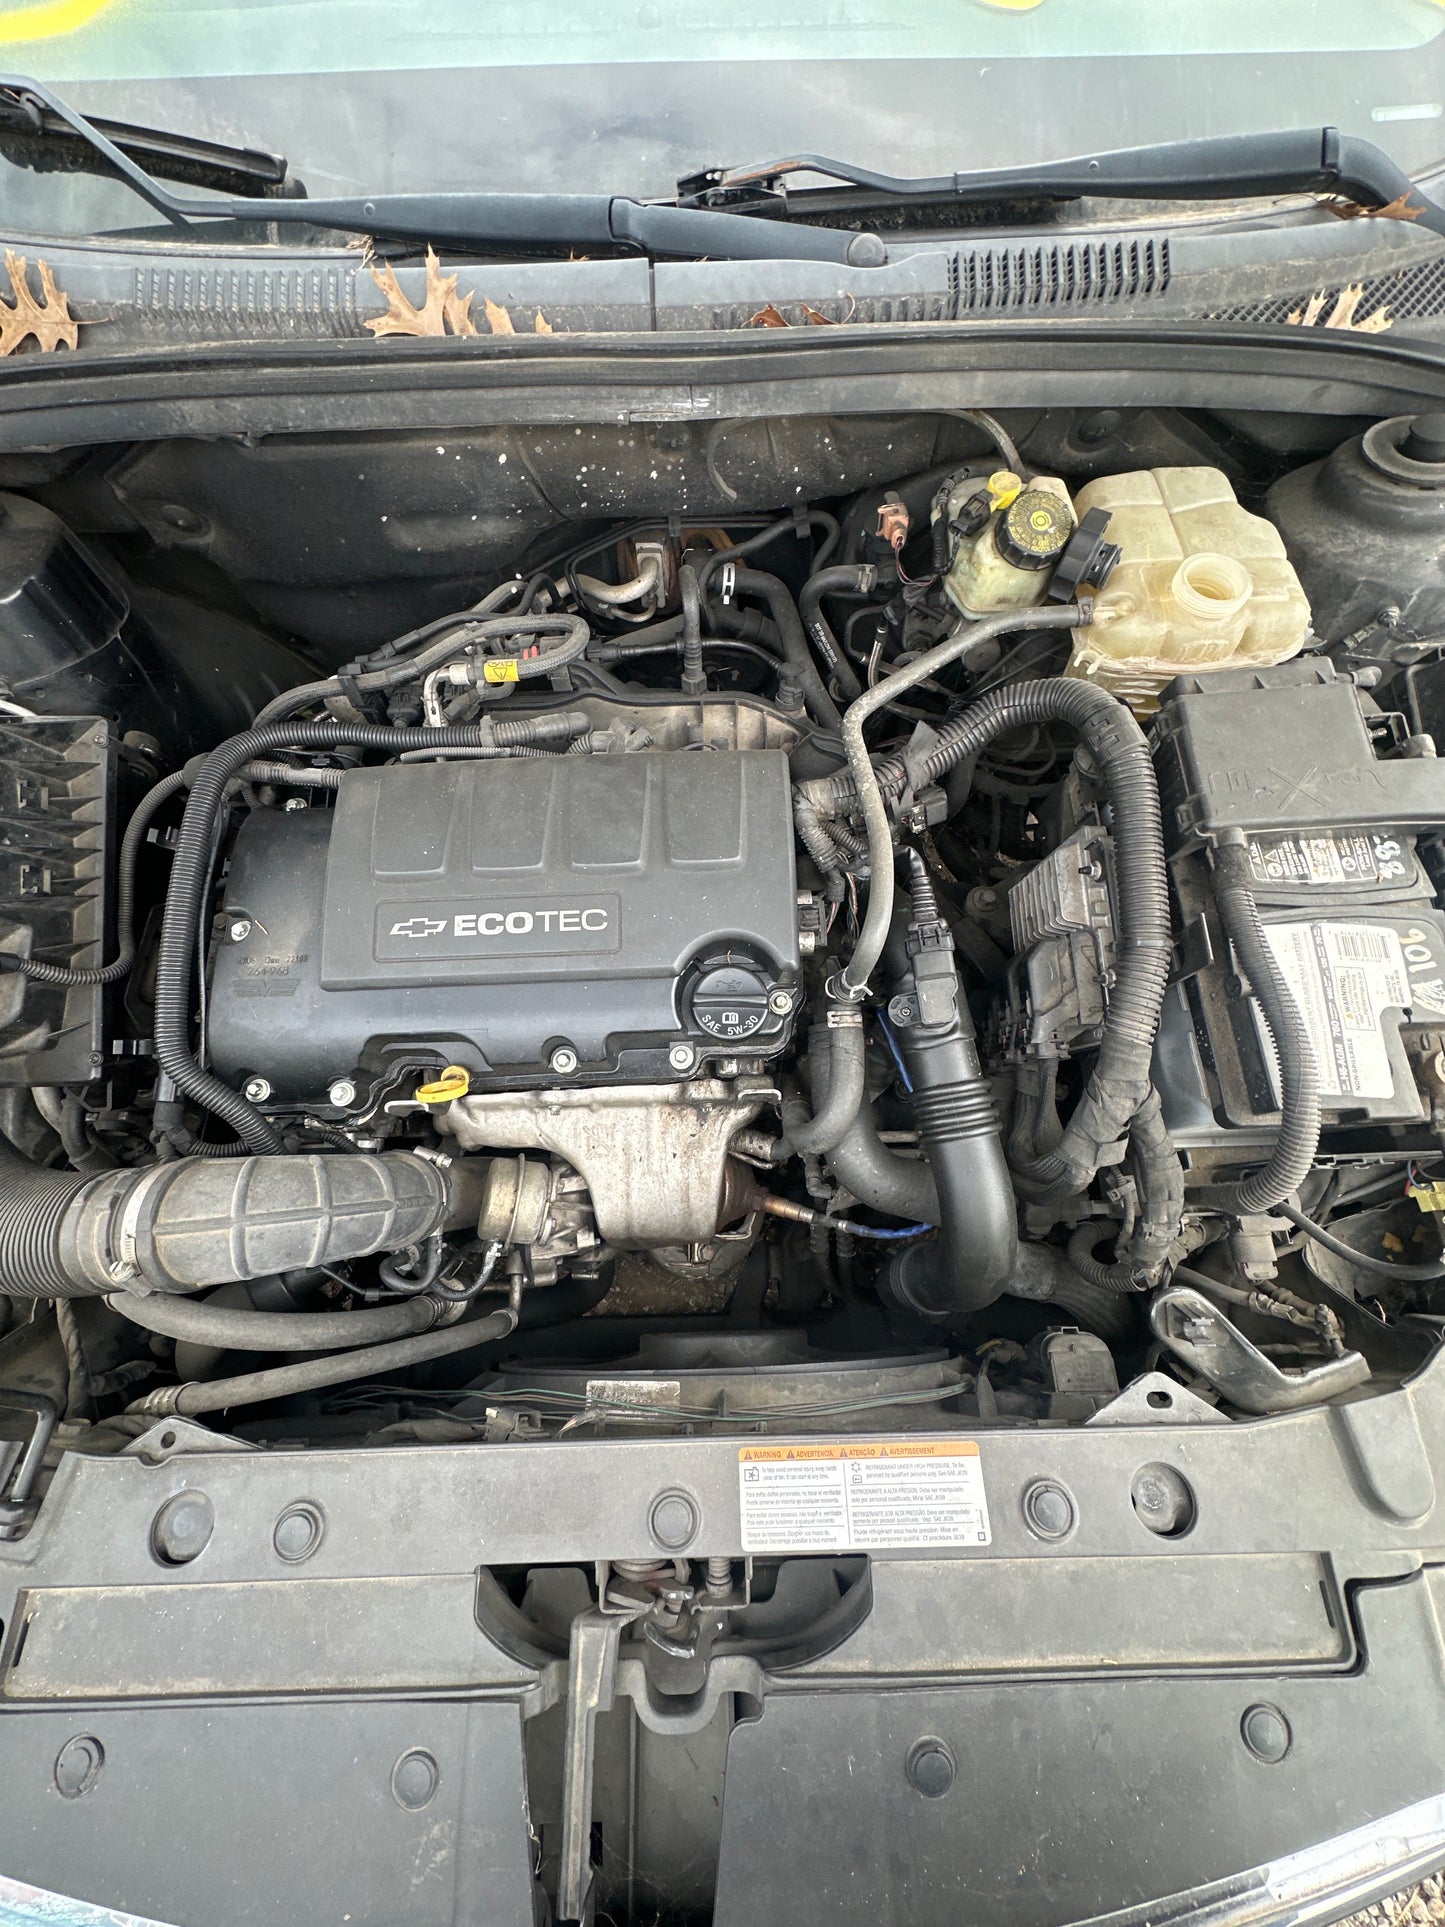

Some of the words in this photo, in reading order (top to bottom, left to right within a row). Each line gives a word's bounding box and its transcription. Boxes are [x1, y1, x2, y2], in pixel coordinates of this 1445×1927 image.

[454, 908, 608, 936] ECOTEC
[1340, 976, 1350, 1012] WARNING:
[702, 1014, 721, 1033] SAE
[727, 1015, 759, 1036] 5W-30
[1347, 1037, 1361, 1091] NON-SPILLABLE
[796, 1450, 834, 1458] ADVERTENCIA
[848, 1448, 875, 1457] ATENÇÃO
[889, 1447, 935, 1456] AVERTISSEMENT
